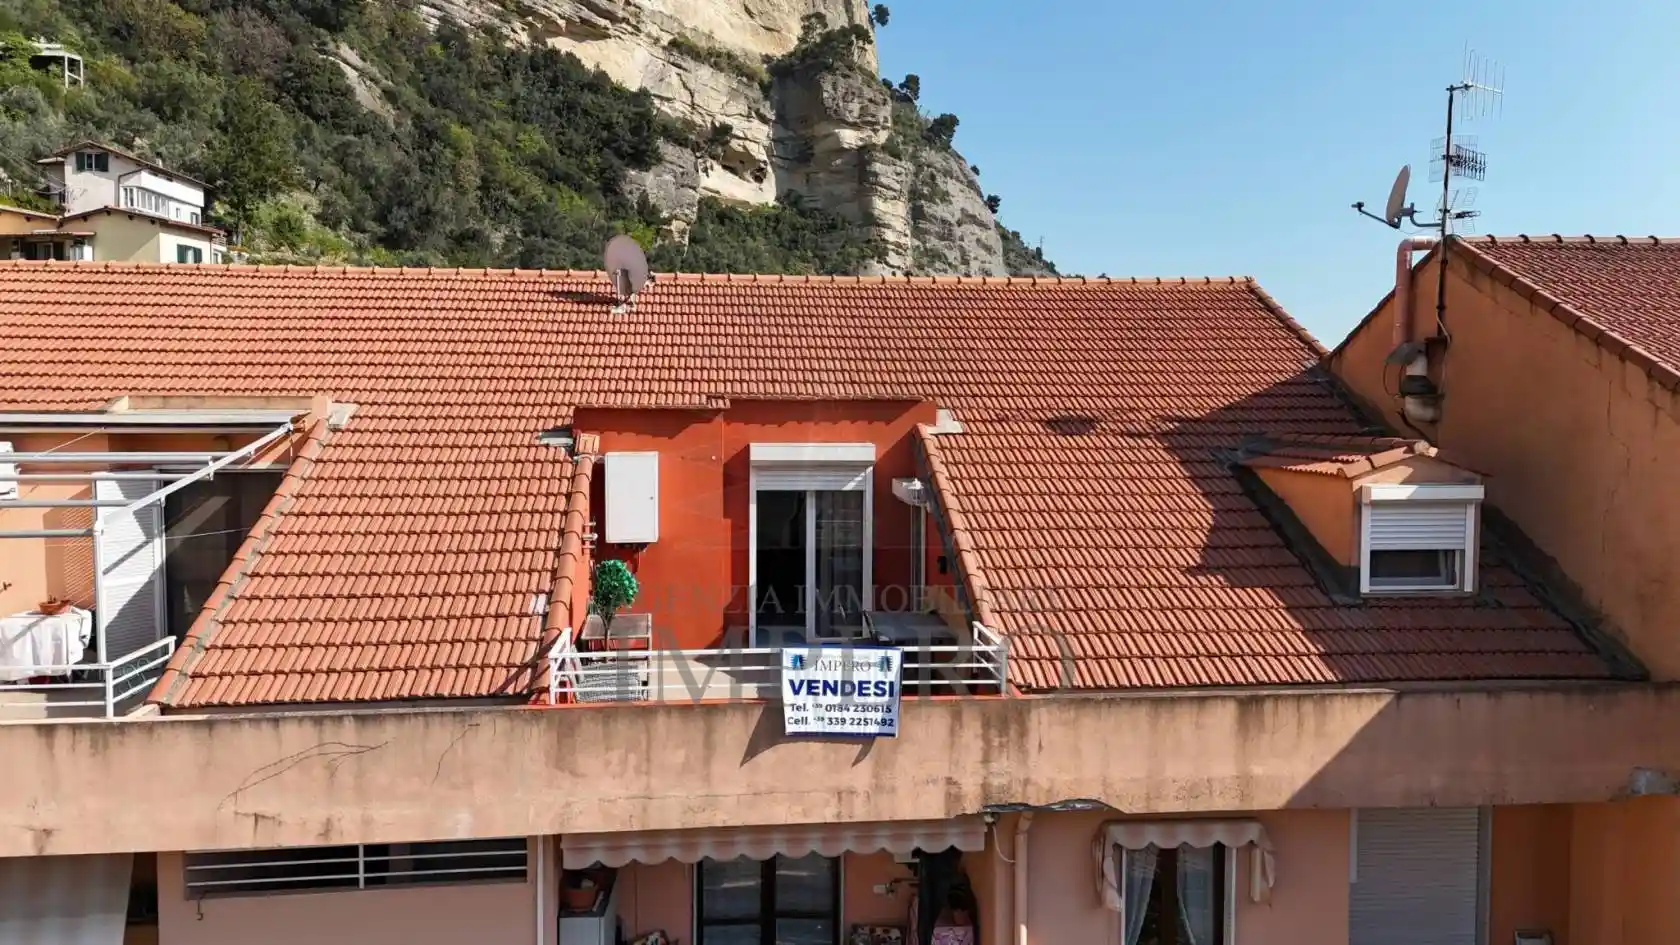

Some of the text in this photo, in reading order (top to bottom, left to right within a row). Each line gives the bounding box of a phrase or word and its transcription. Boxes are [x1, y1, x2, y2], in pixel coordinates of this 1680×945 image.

[814, 659, 871, 673] IMPERO
[788, 679, 895, 698] VENDESI
[790, 703, 809, 712] Tel.
[853, 704, 893, 714] 230615
[787, 716, 811, 726] Cell.
[827, 717, 847, 726] 339
